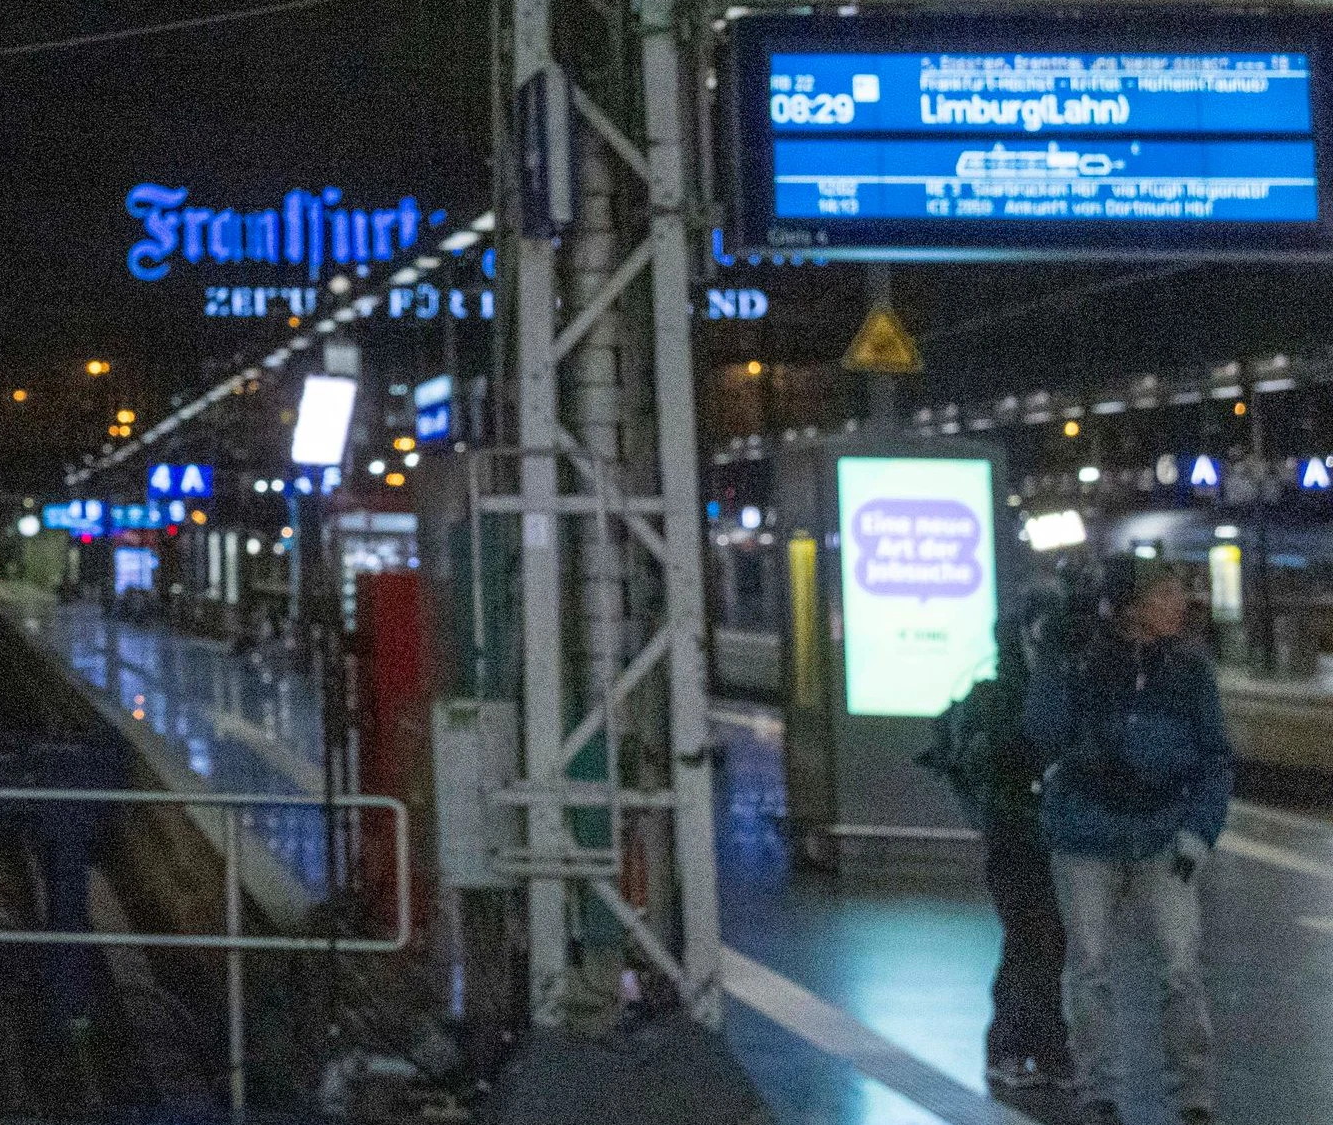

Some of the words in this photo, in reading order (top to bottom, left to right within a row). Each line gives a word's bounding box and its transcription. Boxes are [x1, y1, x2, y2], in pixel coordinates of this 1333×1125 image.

[770, 93, 855, 124] 08:29
[920, 93, 1130, 132] Limburg(Lahn)
[181, 463, 206, 493] A
[1190, 454, 1218, 486] A
[1302, 456, 1330, 488] A
